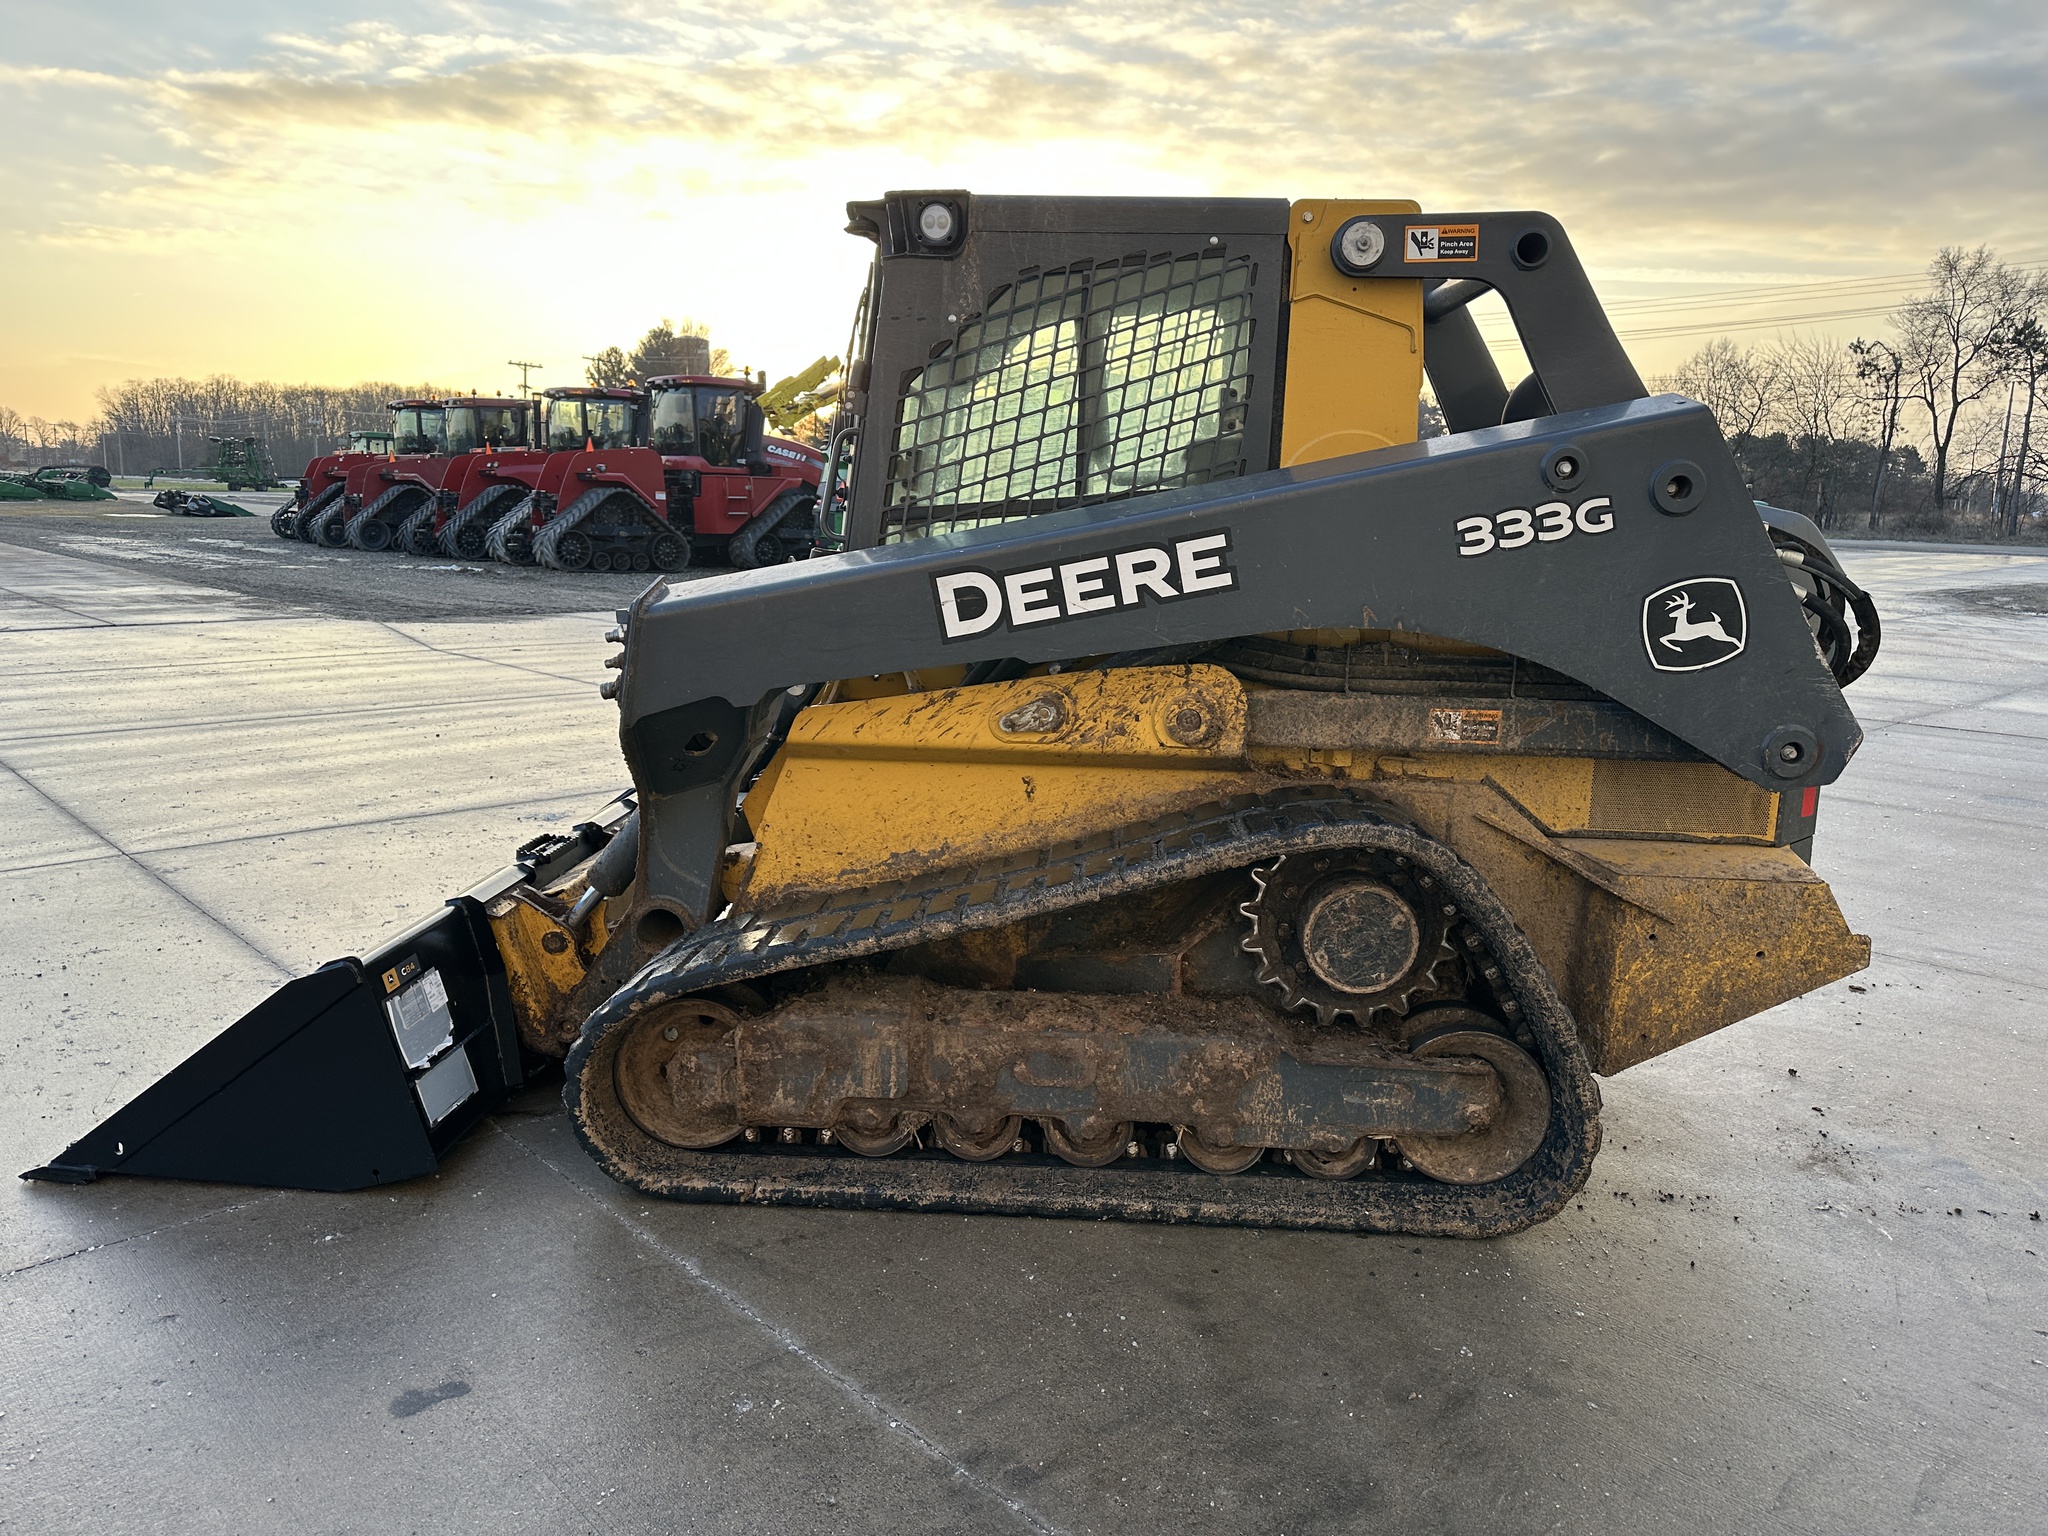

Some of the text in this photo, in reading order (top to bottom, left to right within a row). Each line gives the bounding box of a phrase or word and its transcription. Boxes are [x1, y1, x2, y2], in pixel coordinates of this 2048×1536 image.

[767, 445, 796, 459] CASE
[1456, 497, 1614, 556] 333G
[936, 534, 1233, 638] DEERE
